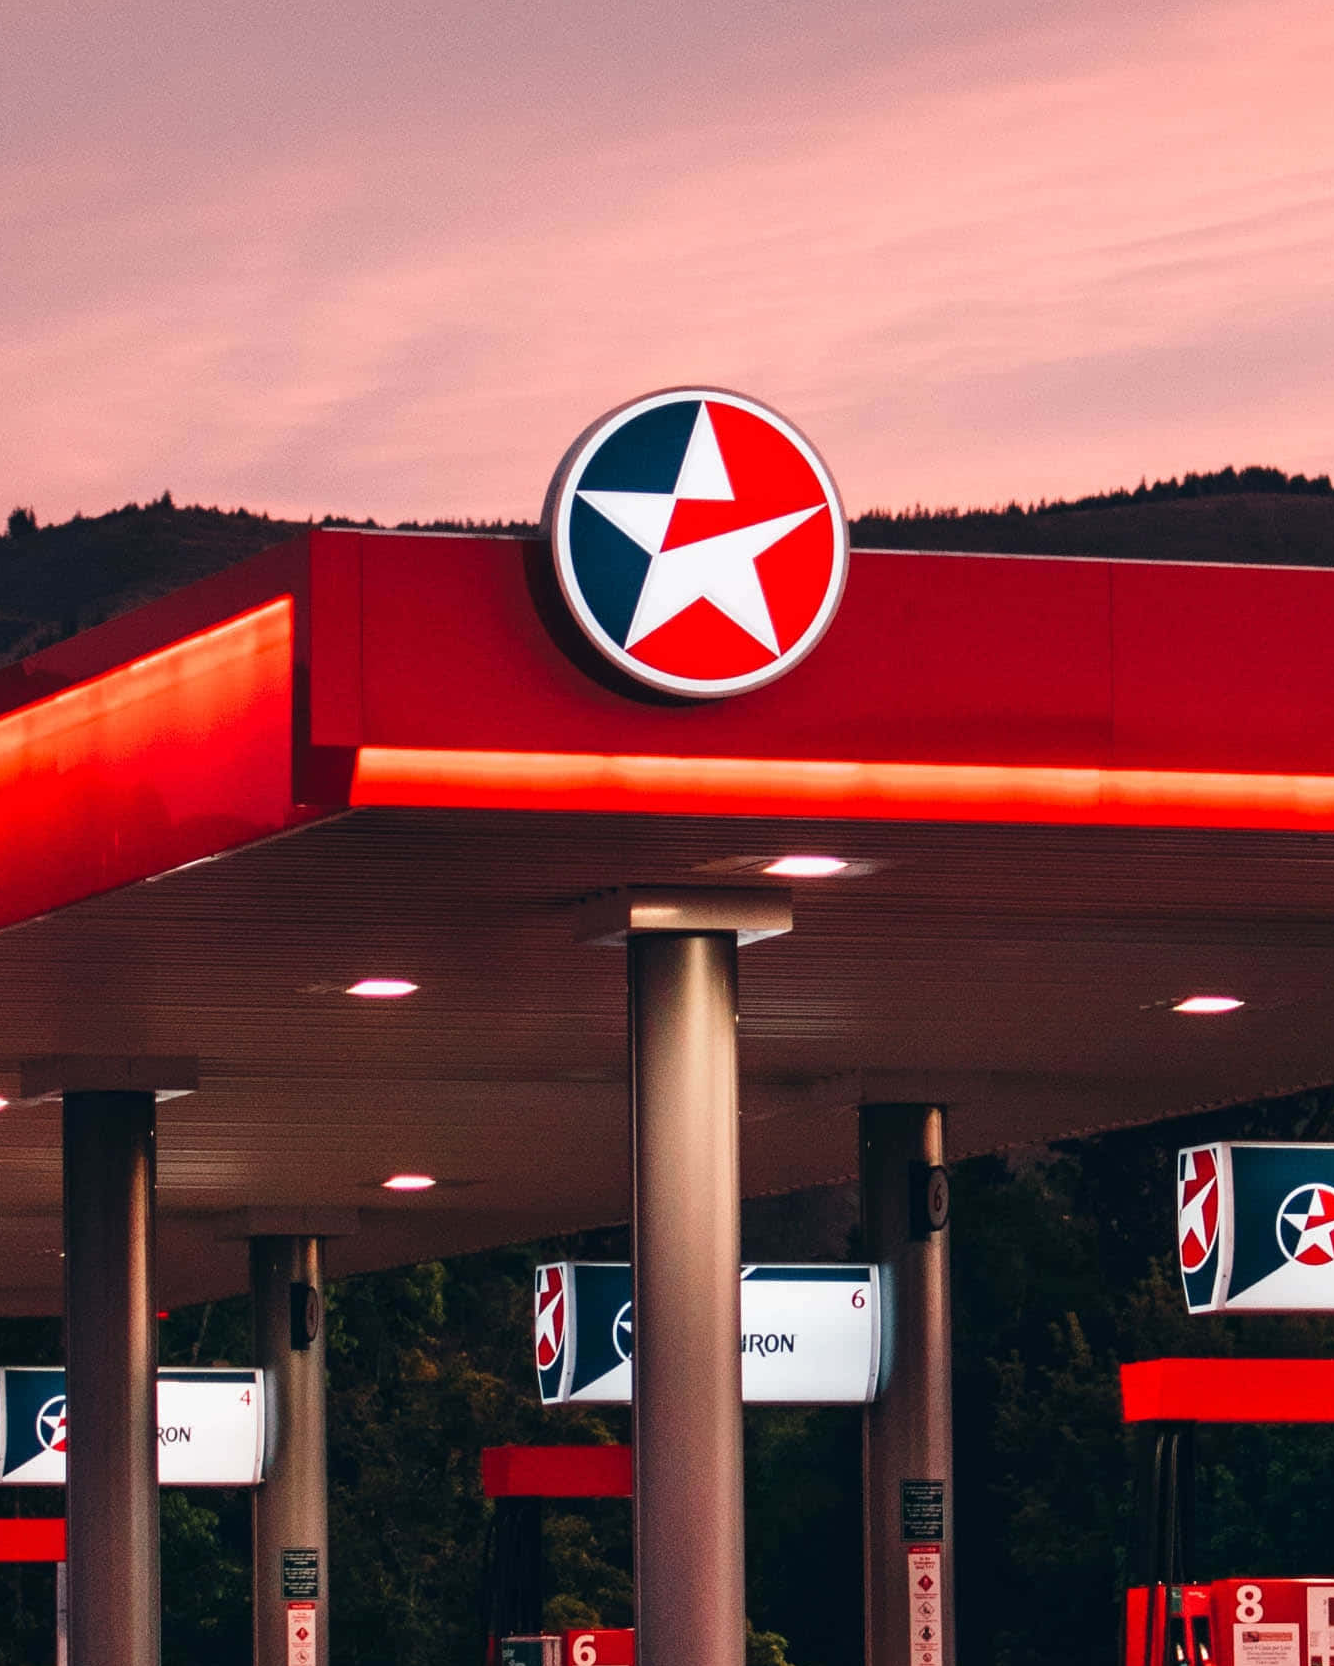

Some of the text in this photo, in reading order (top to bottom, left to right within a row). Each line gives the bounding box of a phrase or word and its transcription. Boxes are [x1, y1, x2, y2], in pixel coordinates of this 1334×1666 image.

[851, 1288, 866, 1309] 6
[239, 1389, 251, 1406] 4
[1235, 1584, 1264, 1624] 8
[572, 1634, 597, 1666] 6
